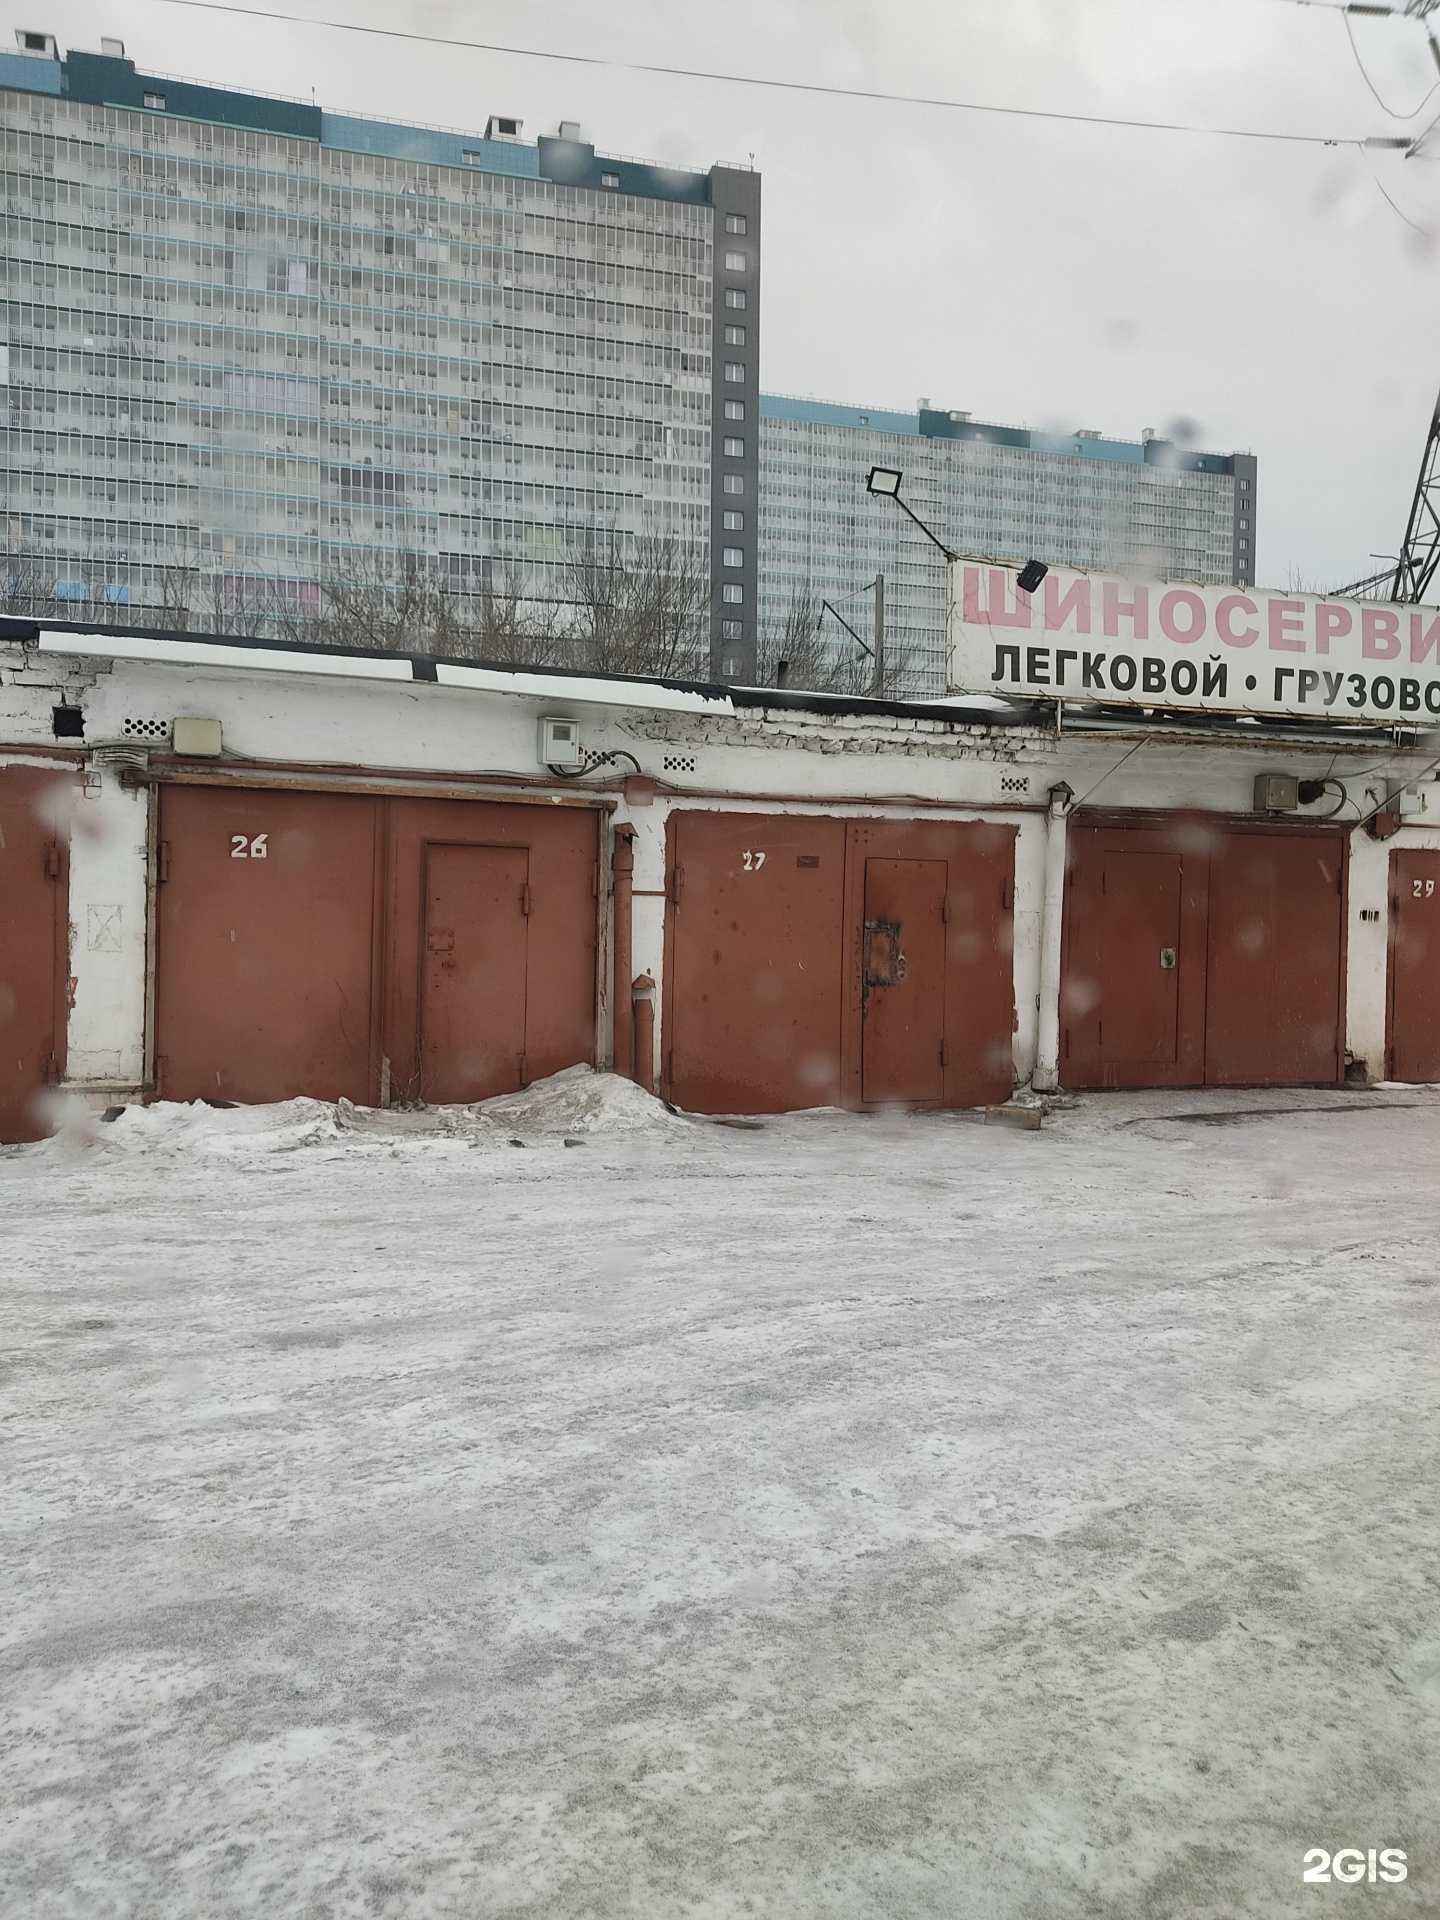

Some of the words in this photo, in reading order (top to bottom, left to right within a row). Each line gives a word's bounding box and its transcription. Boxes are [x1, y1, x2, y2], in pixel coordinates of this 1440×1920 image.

[991, 643, 1228, 698] ЛЕГКОВОЙ
[231, 833, 269, 858] 26
[742, 849, 767, 871] 27
[1412, 879, 1435, 898] 29
